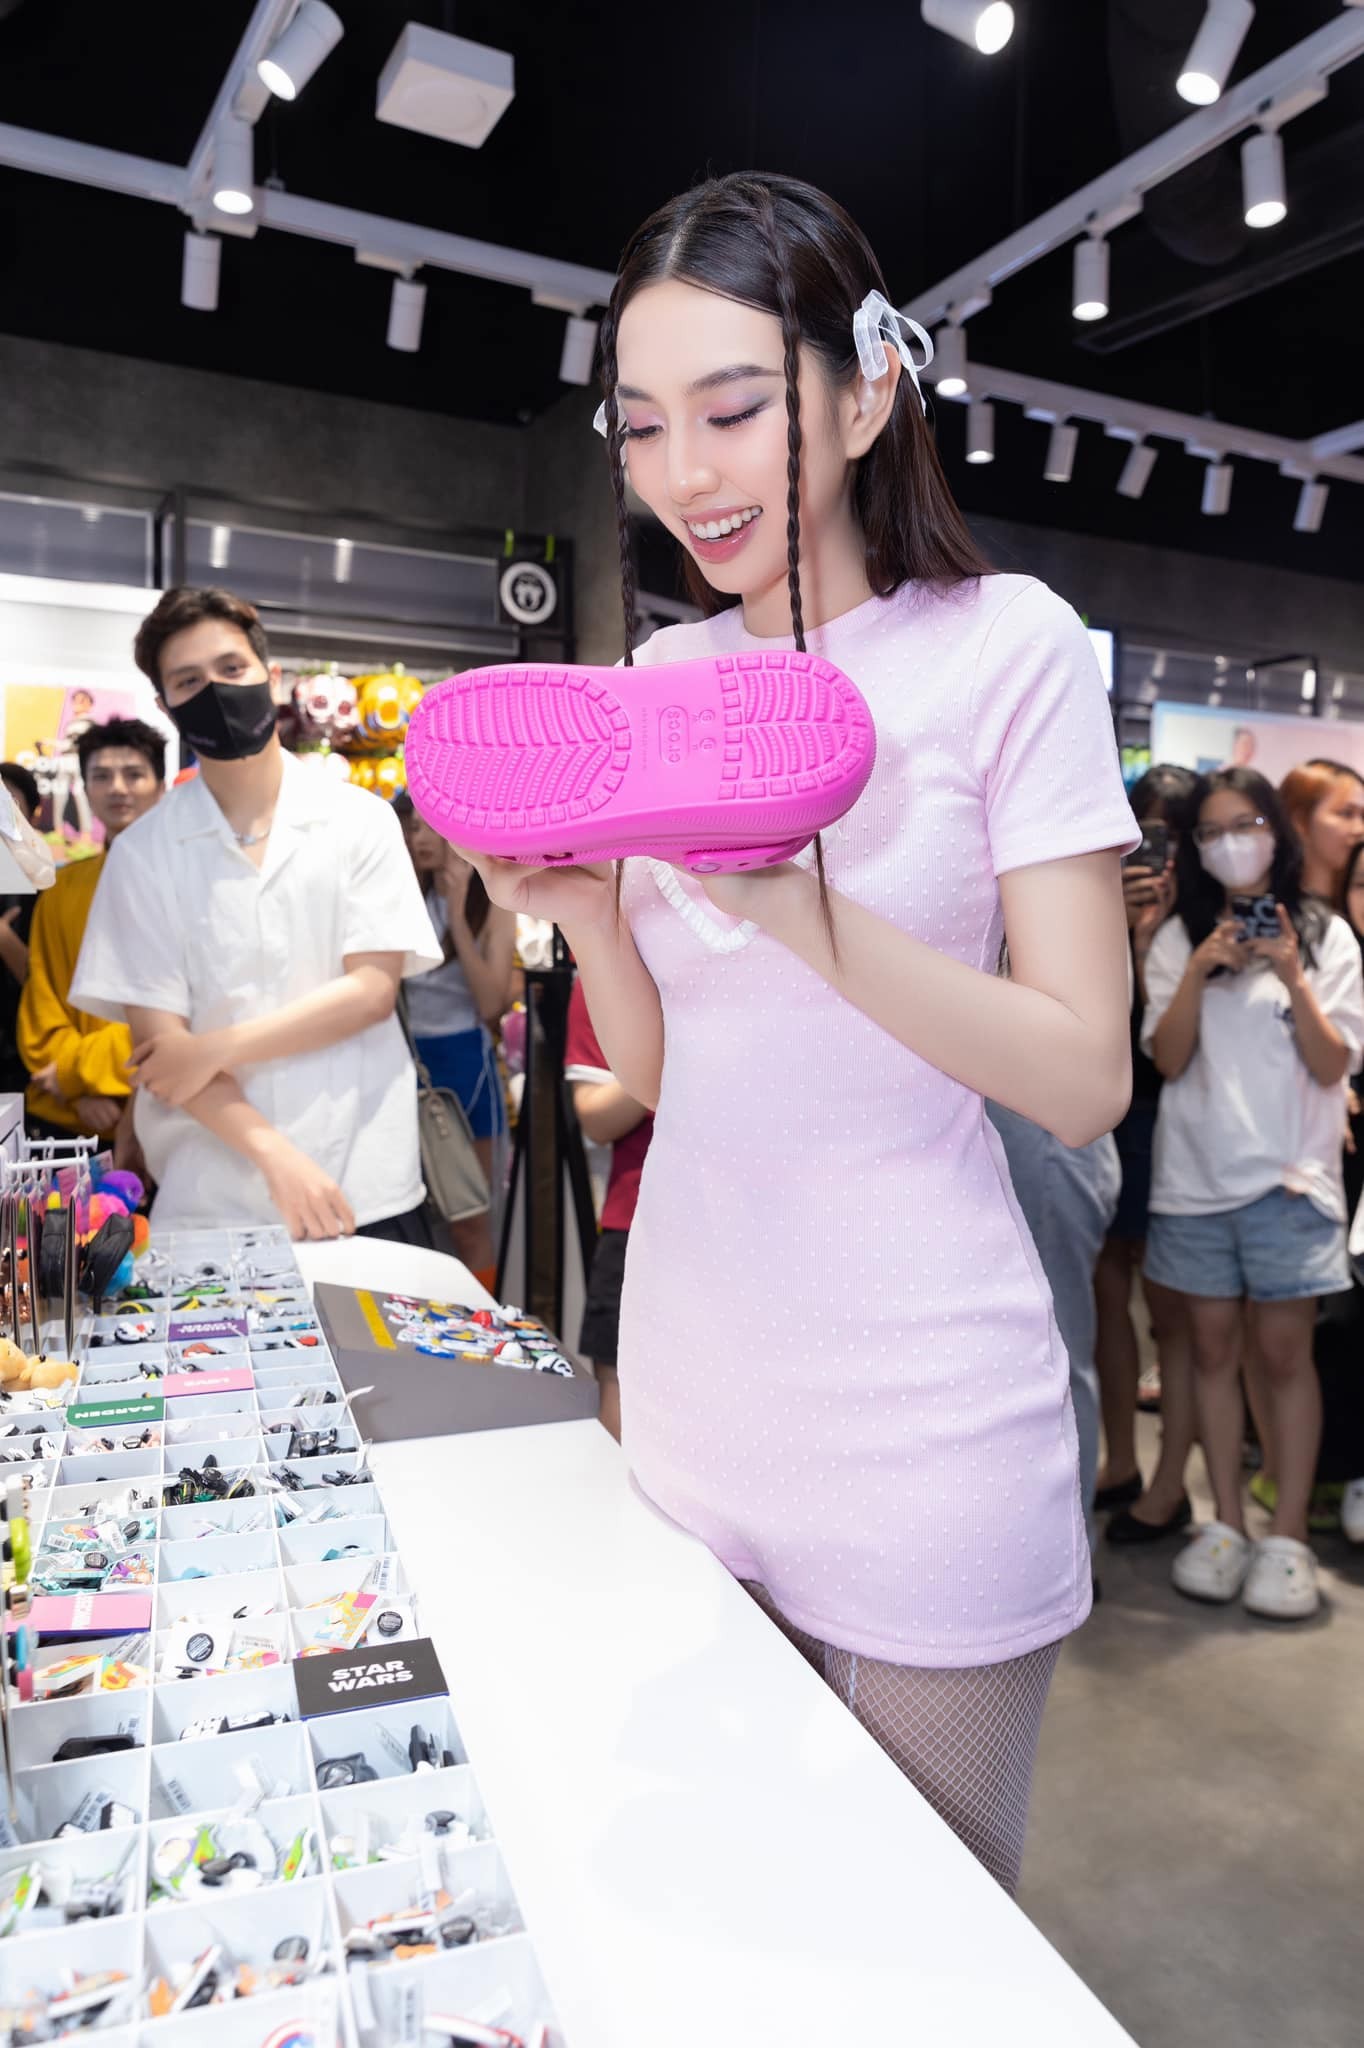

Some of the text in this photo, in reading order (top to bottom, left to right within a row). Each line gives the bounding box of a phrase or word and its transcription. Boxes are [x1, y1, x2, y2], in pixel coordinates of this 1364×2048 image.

[667, 710, 681, 763] crocs
[74, 1405, 156, 1420] GARDEN
[327, 1670, 414, 1693] WARS
[332, 1660, 406, 1681] STAR
